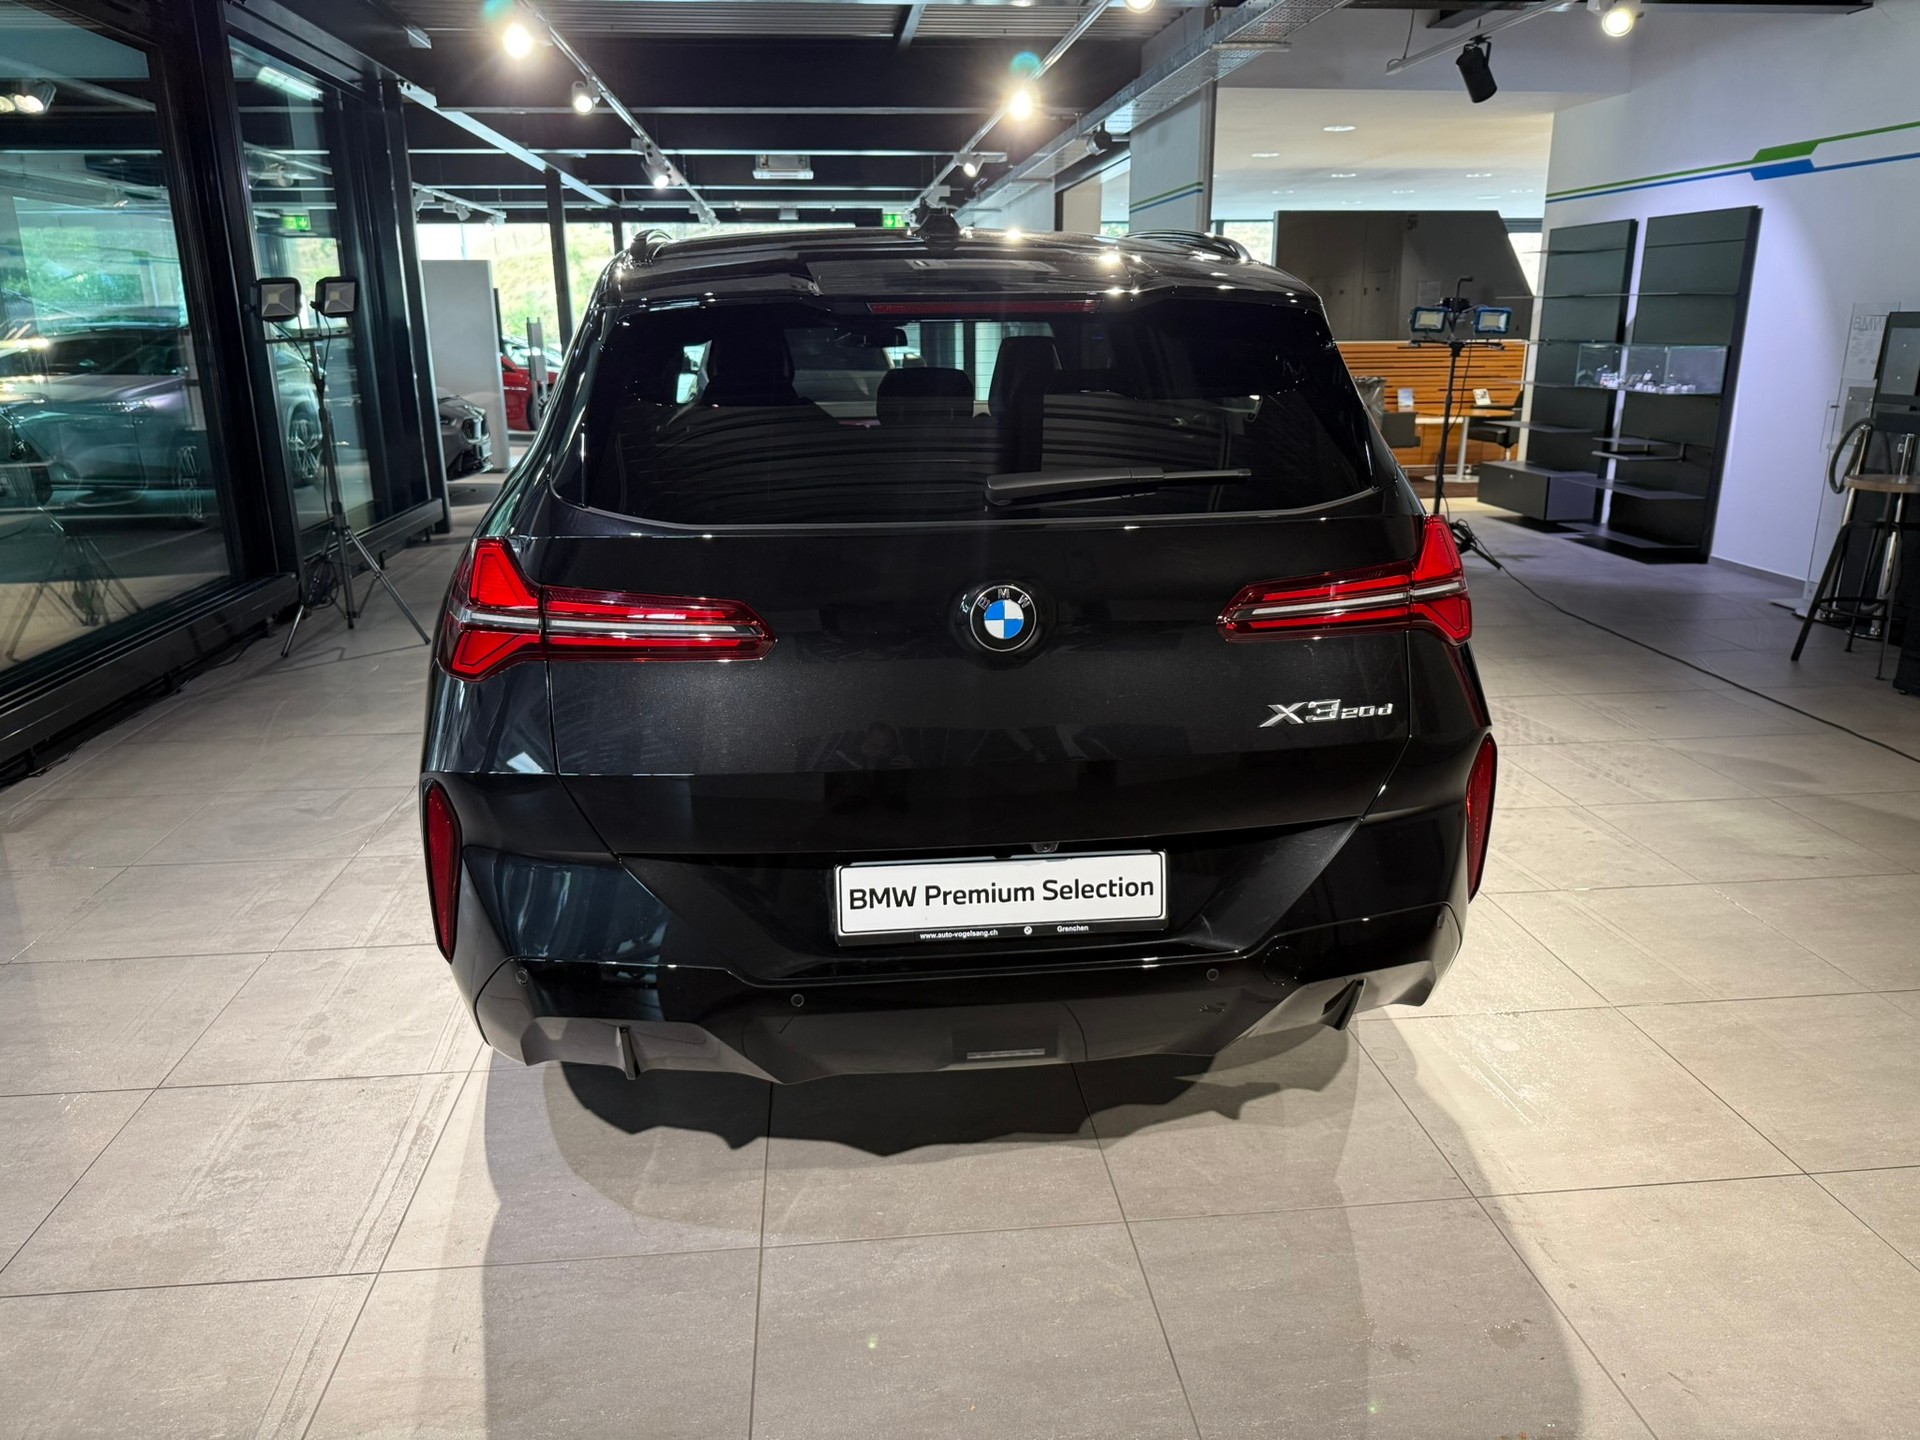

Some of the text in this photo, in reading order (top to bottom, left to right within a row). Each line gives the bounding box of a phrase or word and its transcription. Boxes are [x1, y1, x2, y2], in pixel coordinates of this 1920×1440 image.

[1257, 699, 1394, 728] X3 20d
[849, 877, 1155, 910] BMW Premium Selection
[919, 924, 1089, 940] www.auto-vogelsang.ch Grenchen
